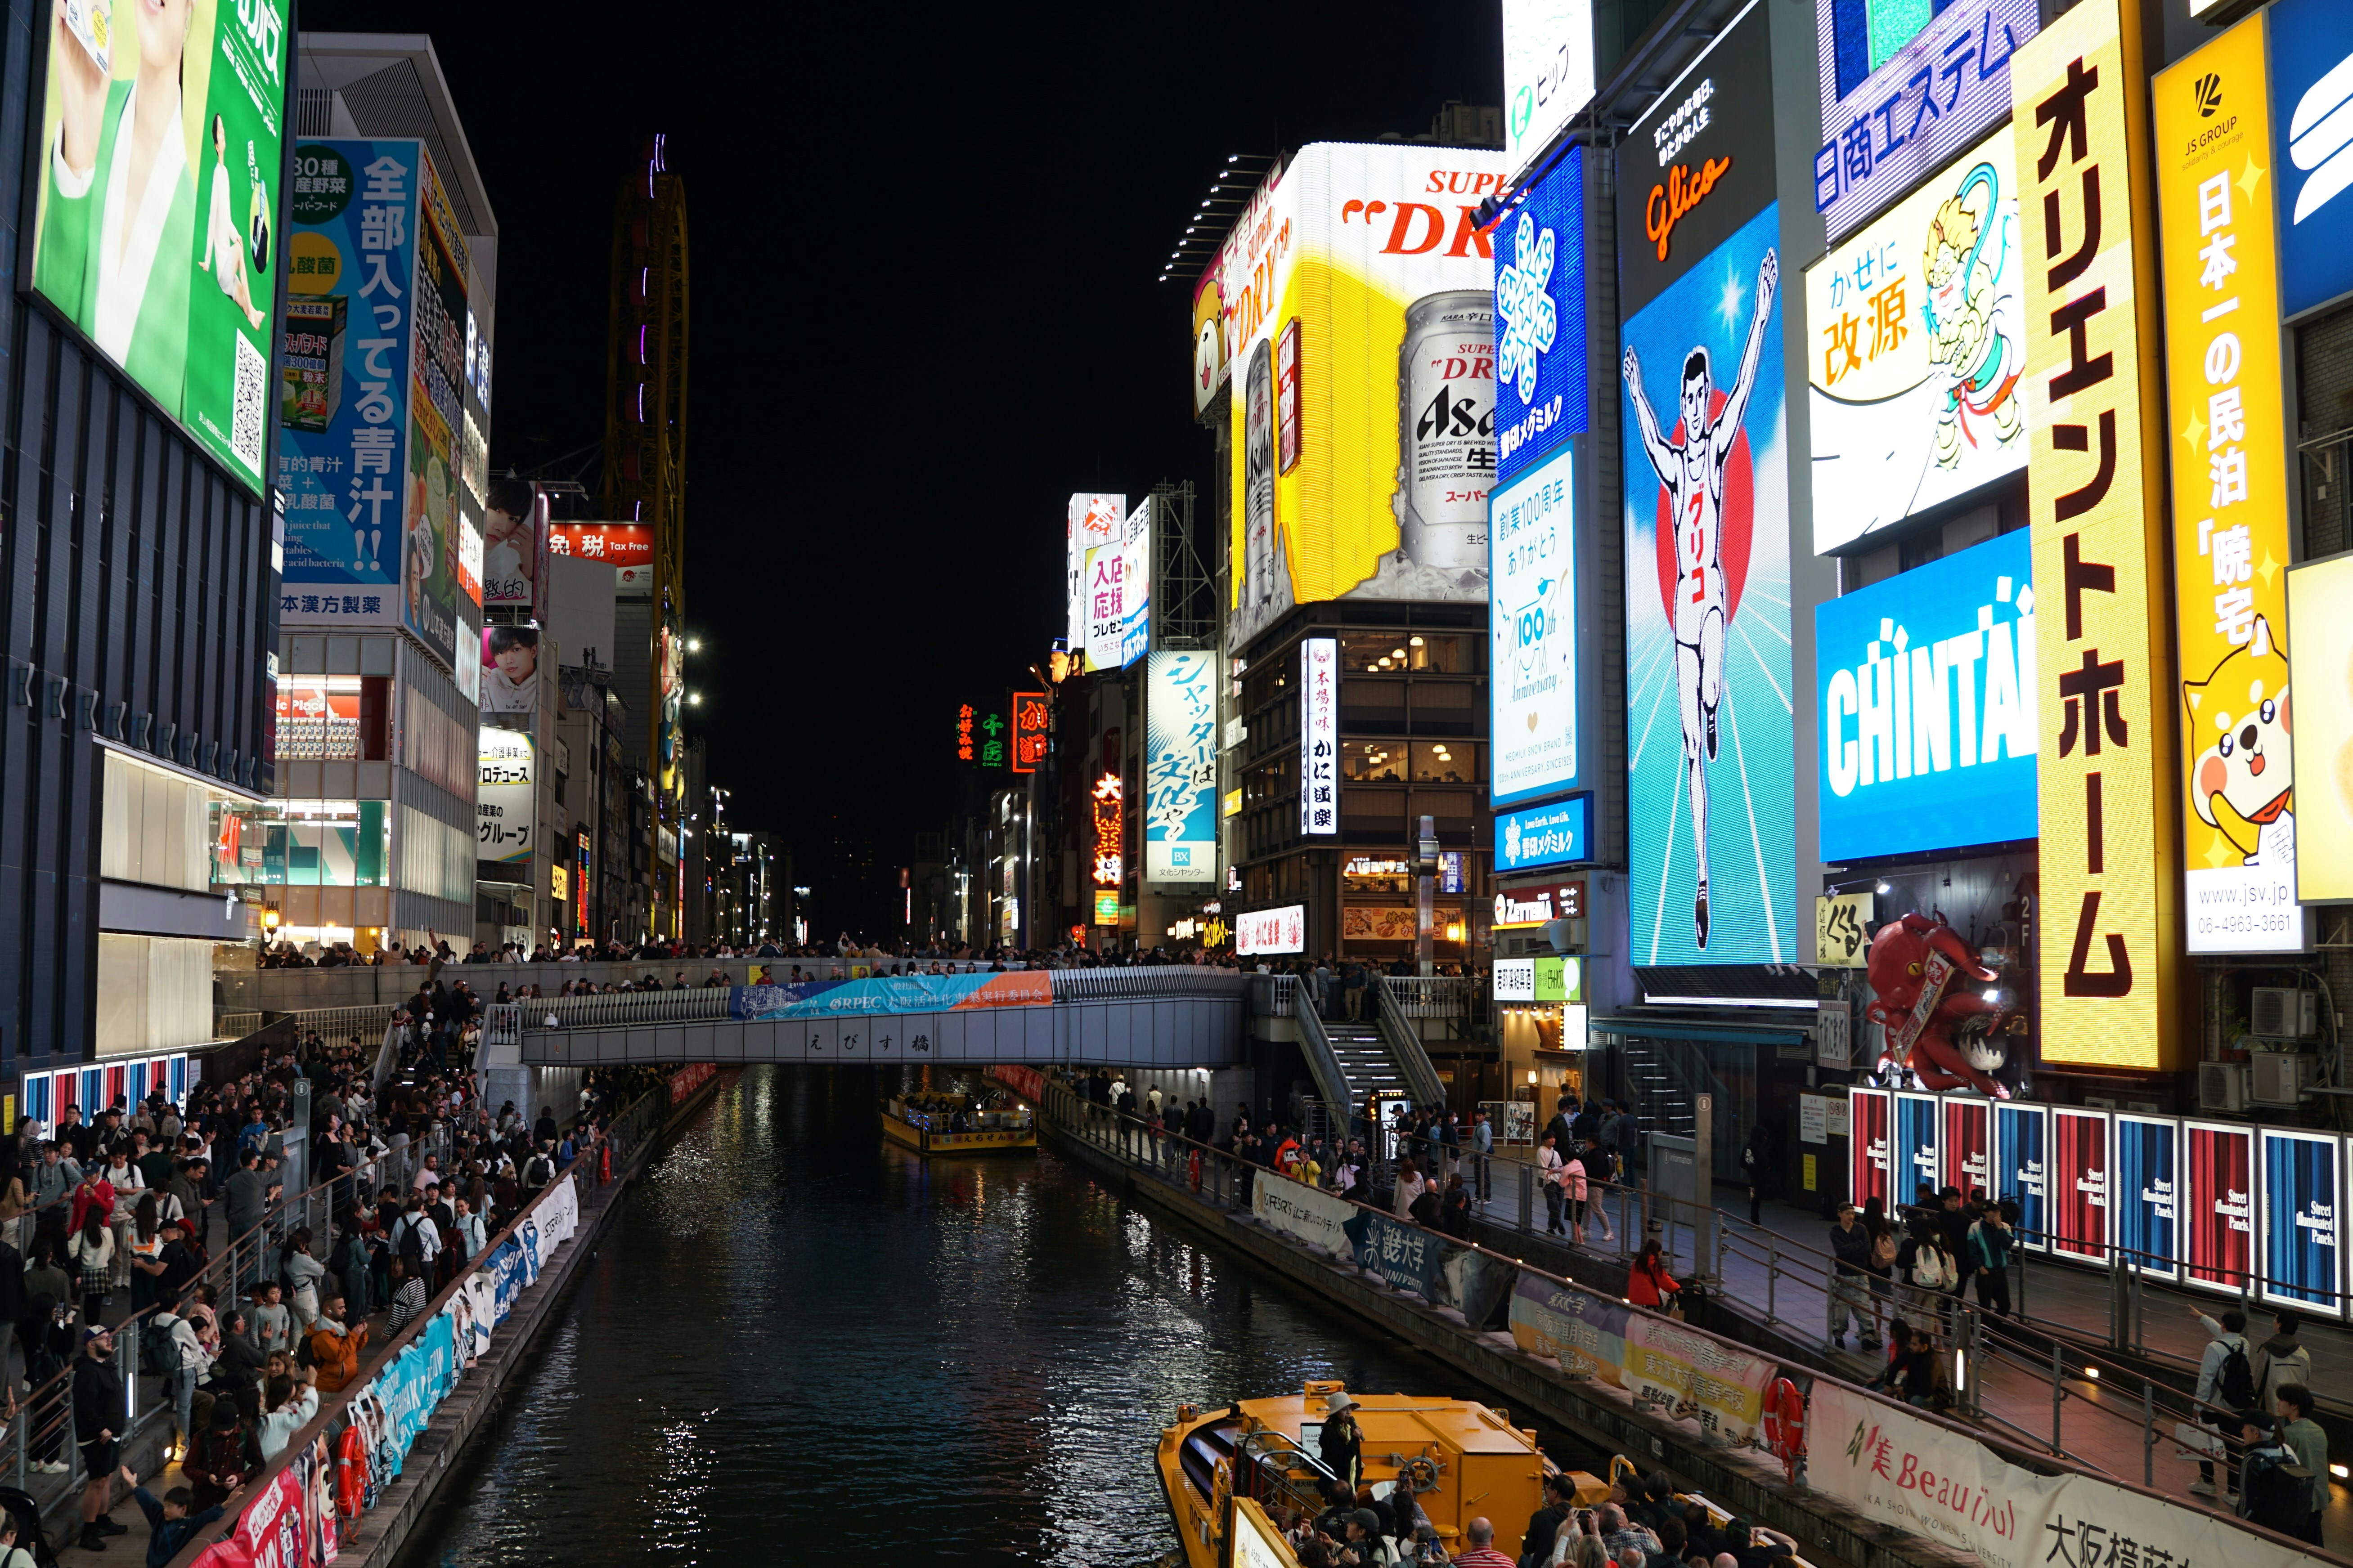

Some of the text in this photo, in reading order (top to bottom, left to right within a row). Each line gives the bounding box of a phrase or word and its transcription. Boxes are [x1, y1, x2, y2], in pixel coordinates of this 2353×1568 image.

[1653, 79, 1715, 148] すこやかな毎日、
[1814, 10, 2016, 214] 日商エステム
[1658, 107, 1710, 166] ゆたかな人生
[2185, 116, 2238, 156] JS GROUP
[2182, 132, 2244, 171] solidarity & courage
[1646, 156, 1729, 261] Glico
[1830, 241, 1898, 309] かぜに
[1823, 274, 1909, 386] 改源
[1500, 394, 1563, 460] 雪印メグミルク
[1499, 477, 1564, 542] 創業100周年
[313, 521, 331, 529] that
[2035, 55, 2133, 998] オリエントホーム
[610, 542, 626, 551] Tax
[629, 542, 649, 551] Free
[1508, 526, 1556, 577] ありがとう
[1688, 482, 1706, 604] グリコ
[309, 558, 345, 567] bacteria
[292, 699, 327, 712] Place
[1505, 738, 1562, 762] MEGMILK SNOW BRAND
[1525, 819, 1536, 829] Love
[1549, 815, 1559, 824] Love
[1173, 852, 1189, 862] BX
[1522, 830, 1573, 859] 雪印メグミルク
[2199, 881, 2288, 907] www.jsv.jp
[2198, 914, 2290, 933] 06-4963-3661
[810, 1034, 930, 1053] えびす橋
[963, 1133, 1007, 1143] えちぜん
[2027, 1159, 2042, 1173] Street
[2088, 1168, 2104, 1182] Street
[2154, 1178, 2172, 1193] Street
[2228, 1189, 2247, 1205] Street
[2310, 1200, 2332, 1218] Street
[1871, 1435, 1893, 1481] 美
[2045, 1514, 2190, 1568] 大阪樟蔭
